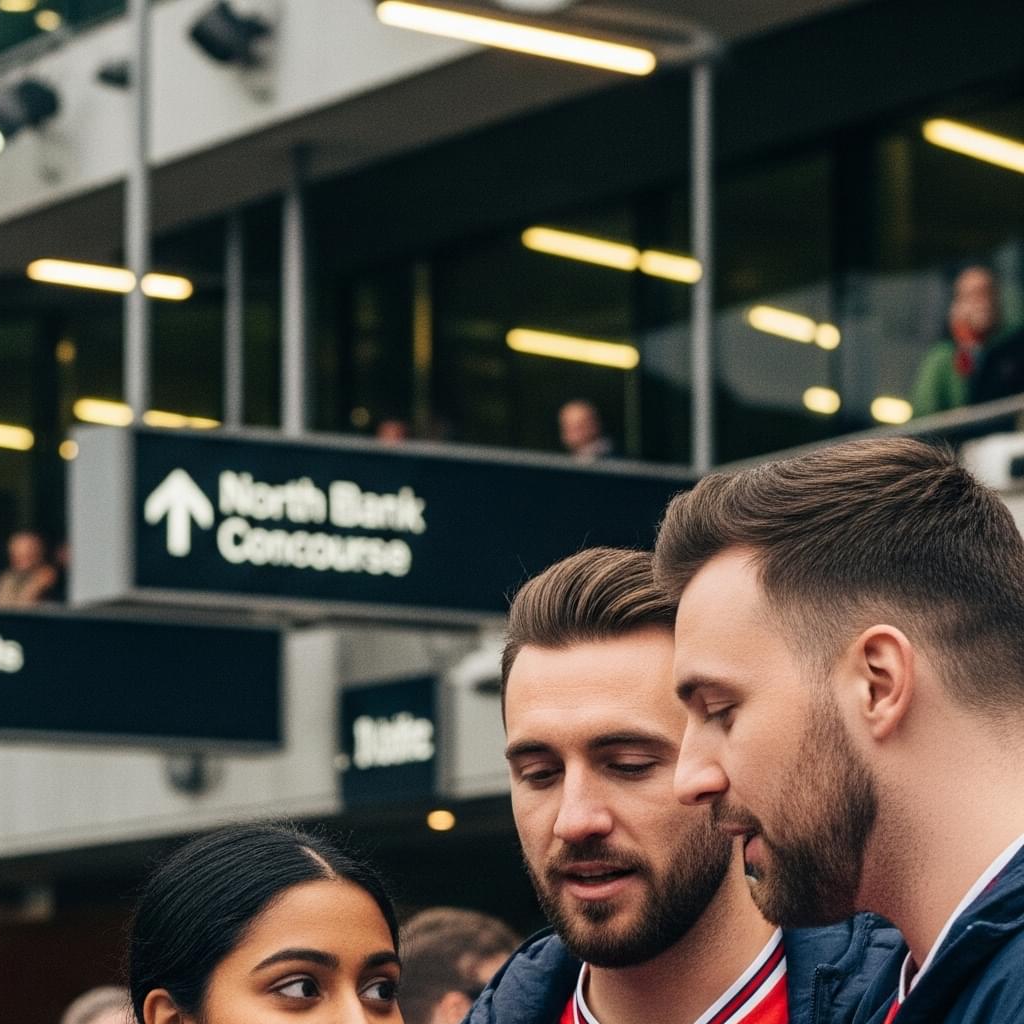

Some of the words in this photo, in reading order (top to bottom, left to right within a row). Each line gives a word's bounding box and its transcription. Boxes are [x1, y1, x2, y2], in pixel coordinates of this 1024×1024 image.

[219, 470, 326, 524] North
[328, 480, 426, 535] Bank
[217, 516, 413, 578] Concourse
